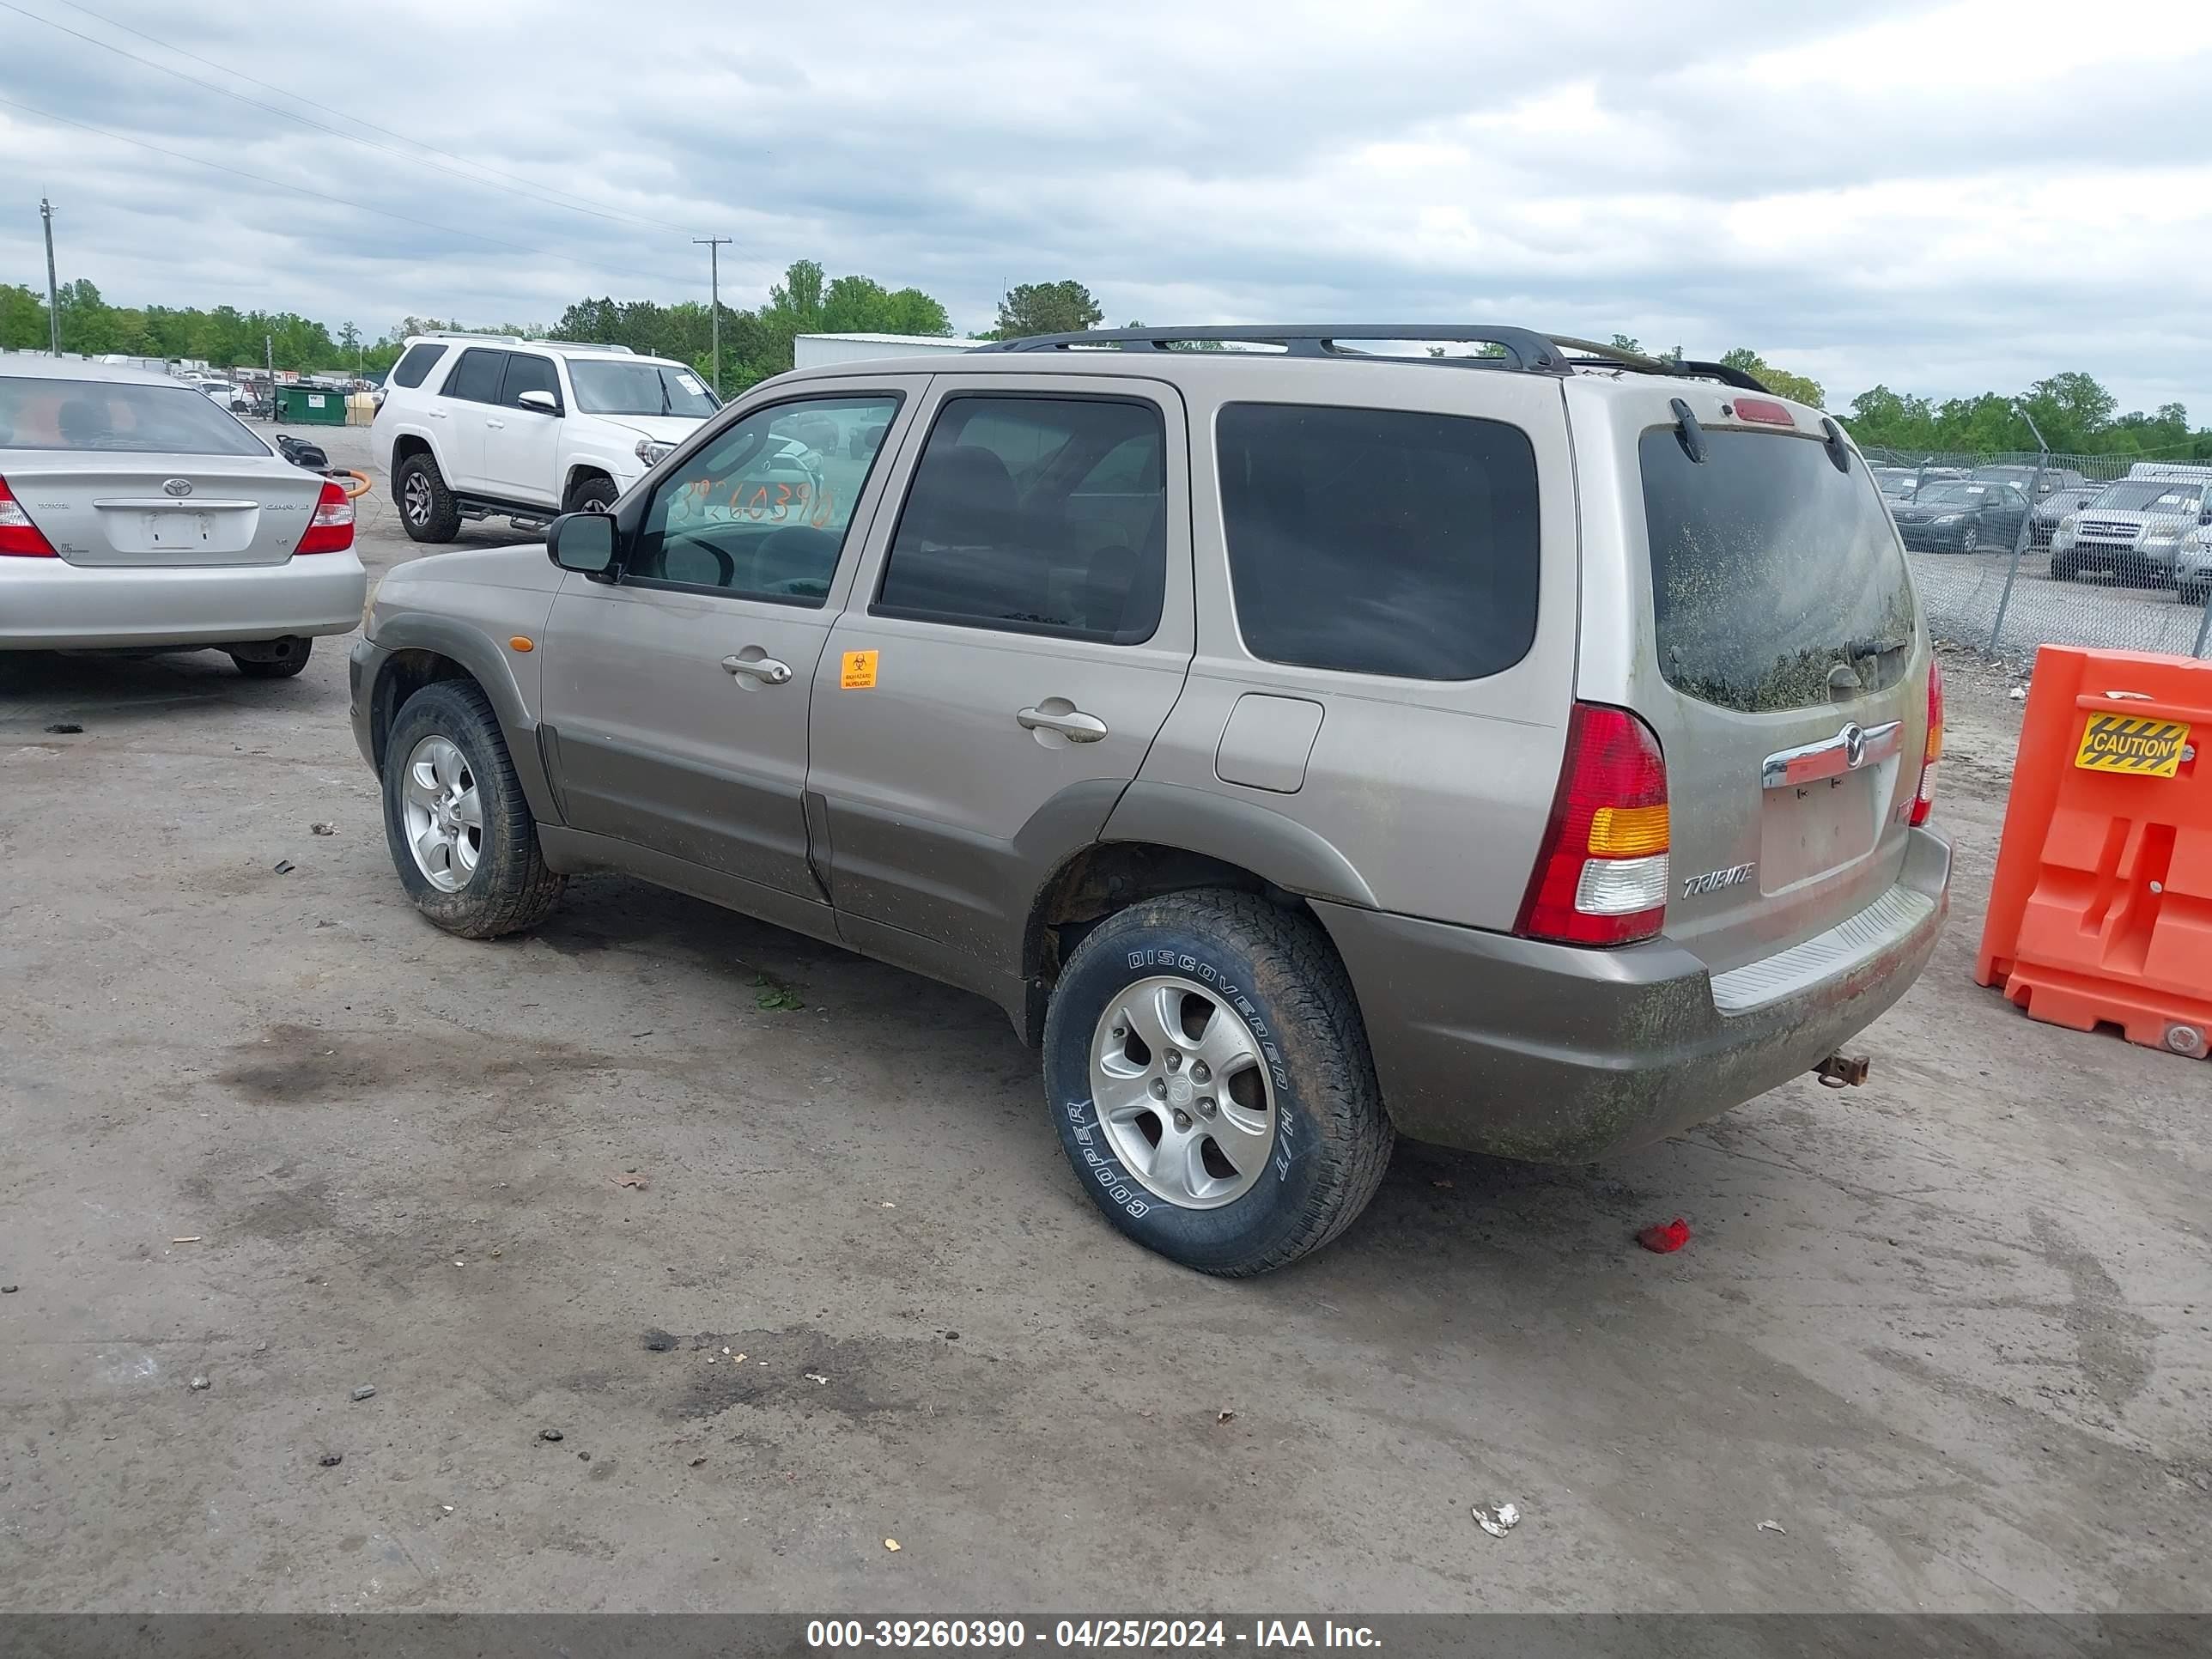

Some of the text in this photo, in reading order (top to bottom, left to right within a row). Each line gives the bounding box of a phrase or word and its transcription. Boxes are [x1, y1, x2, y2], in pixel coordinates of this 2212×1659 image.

[2094, 732, 2172, 757] CAUTION
[1681, 861, 1756, 900] TRIBUTE
[1127, 950, 1294, 1183] DISCOVERER H/T
[1067, 1103, 1149, 1219] COOPER
